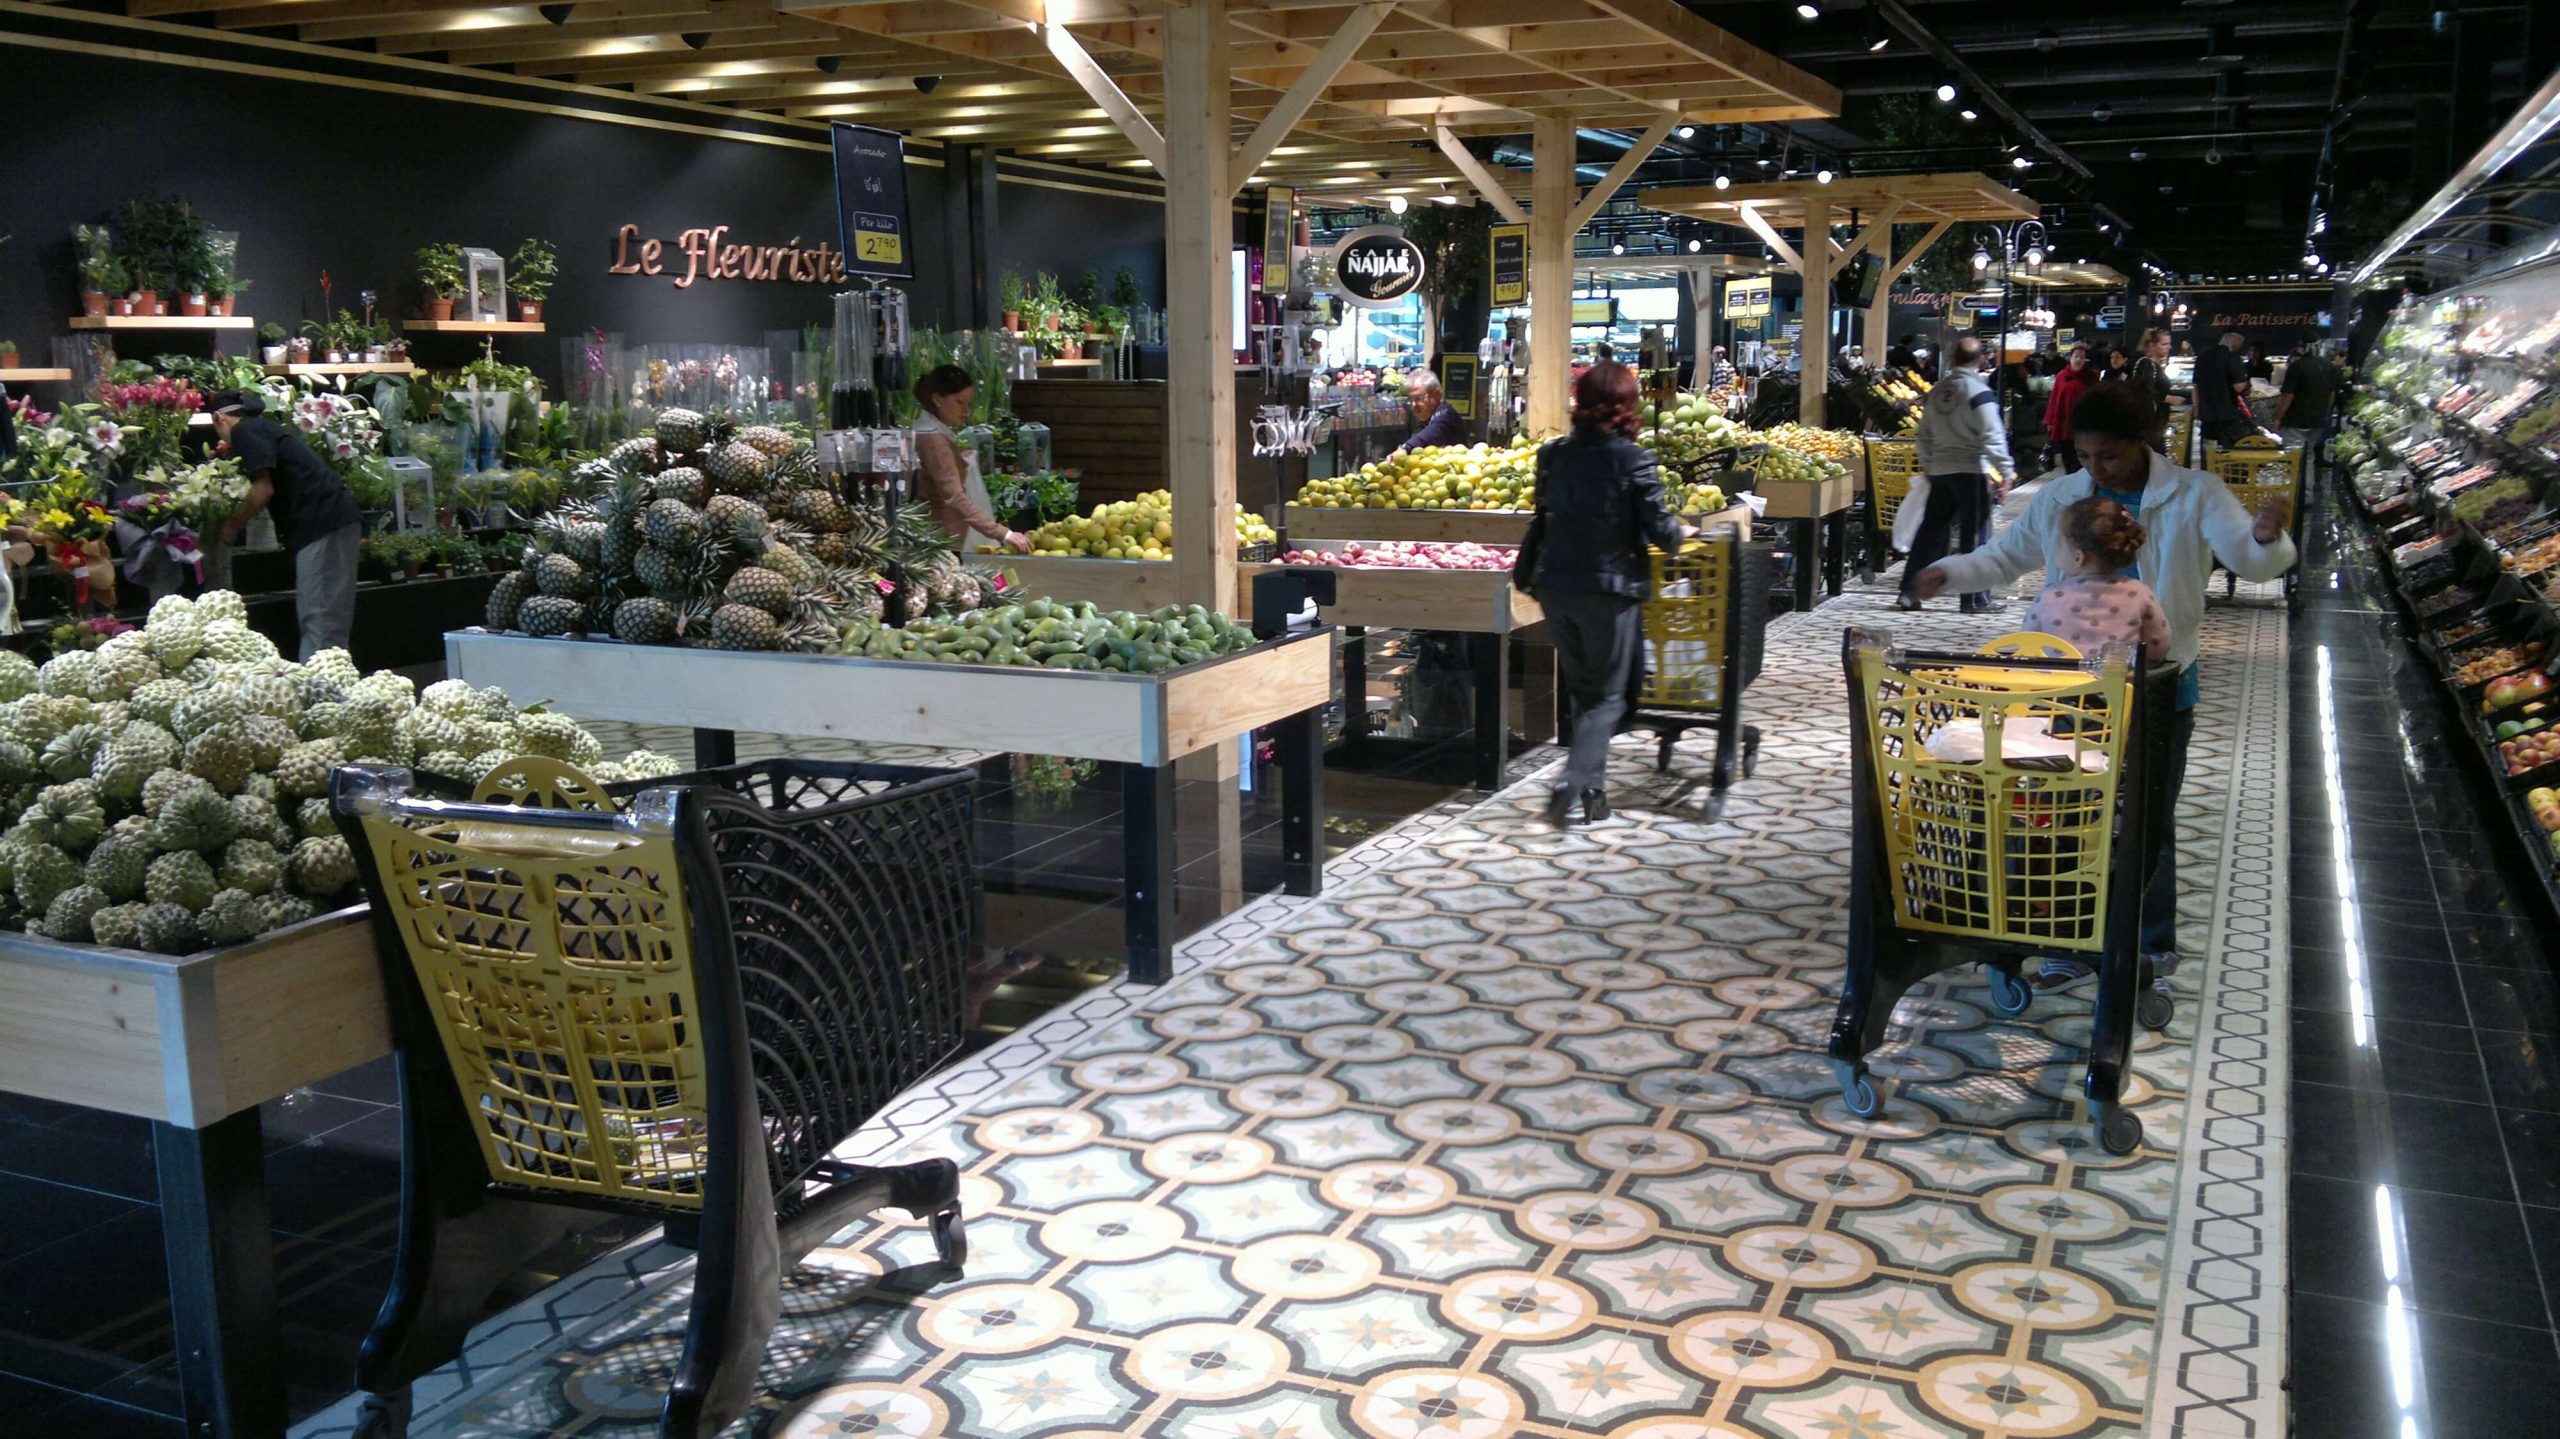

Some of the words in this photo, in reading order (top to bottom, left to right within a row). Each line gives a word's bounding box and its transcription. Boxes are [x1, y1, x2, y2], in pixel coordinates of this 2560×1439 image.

[853, 145, 887, 158] Avocado
[608, 223, 663, 275] Le
[673, 225, 847, 289] Fleuriste
[1349, 248, 1410, 257] CAFE
[1348, 256, 1410, 277] NAJJAR
[1370, 265, 1415, 298] Gourmet
[2211, 313, 2233, 327] La
[2237, 312, 2317, 327] Patisserie
